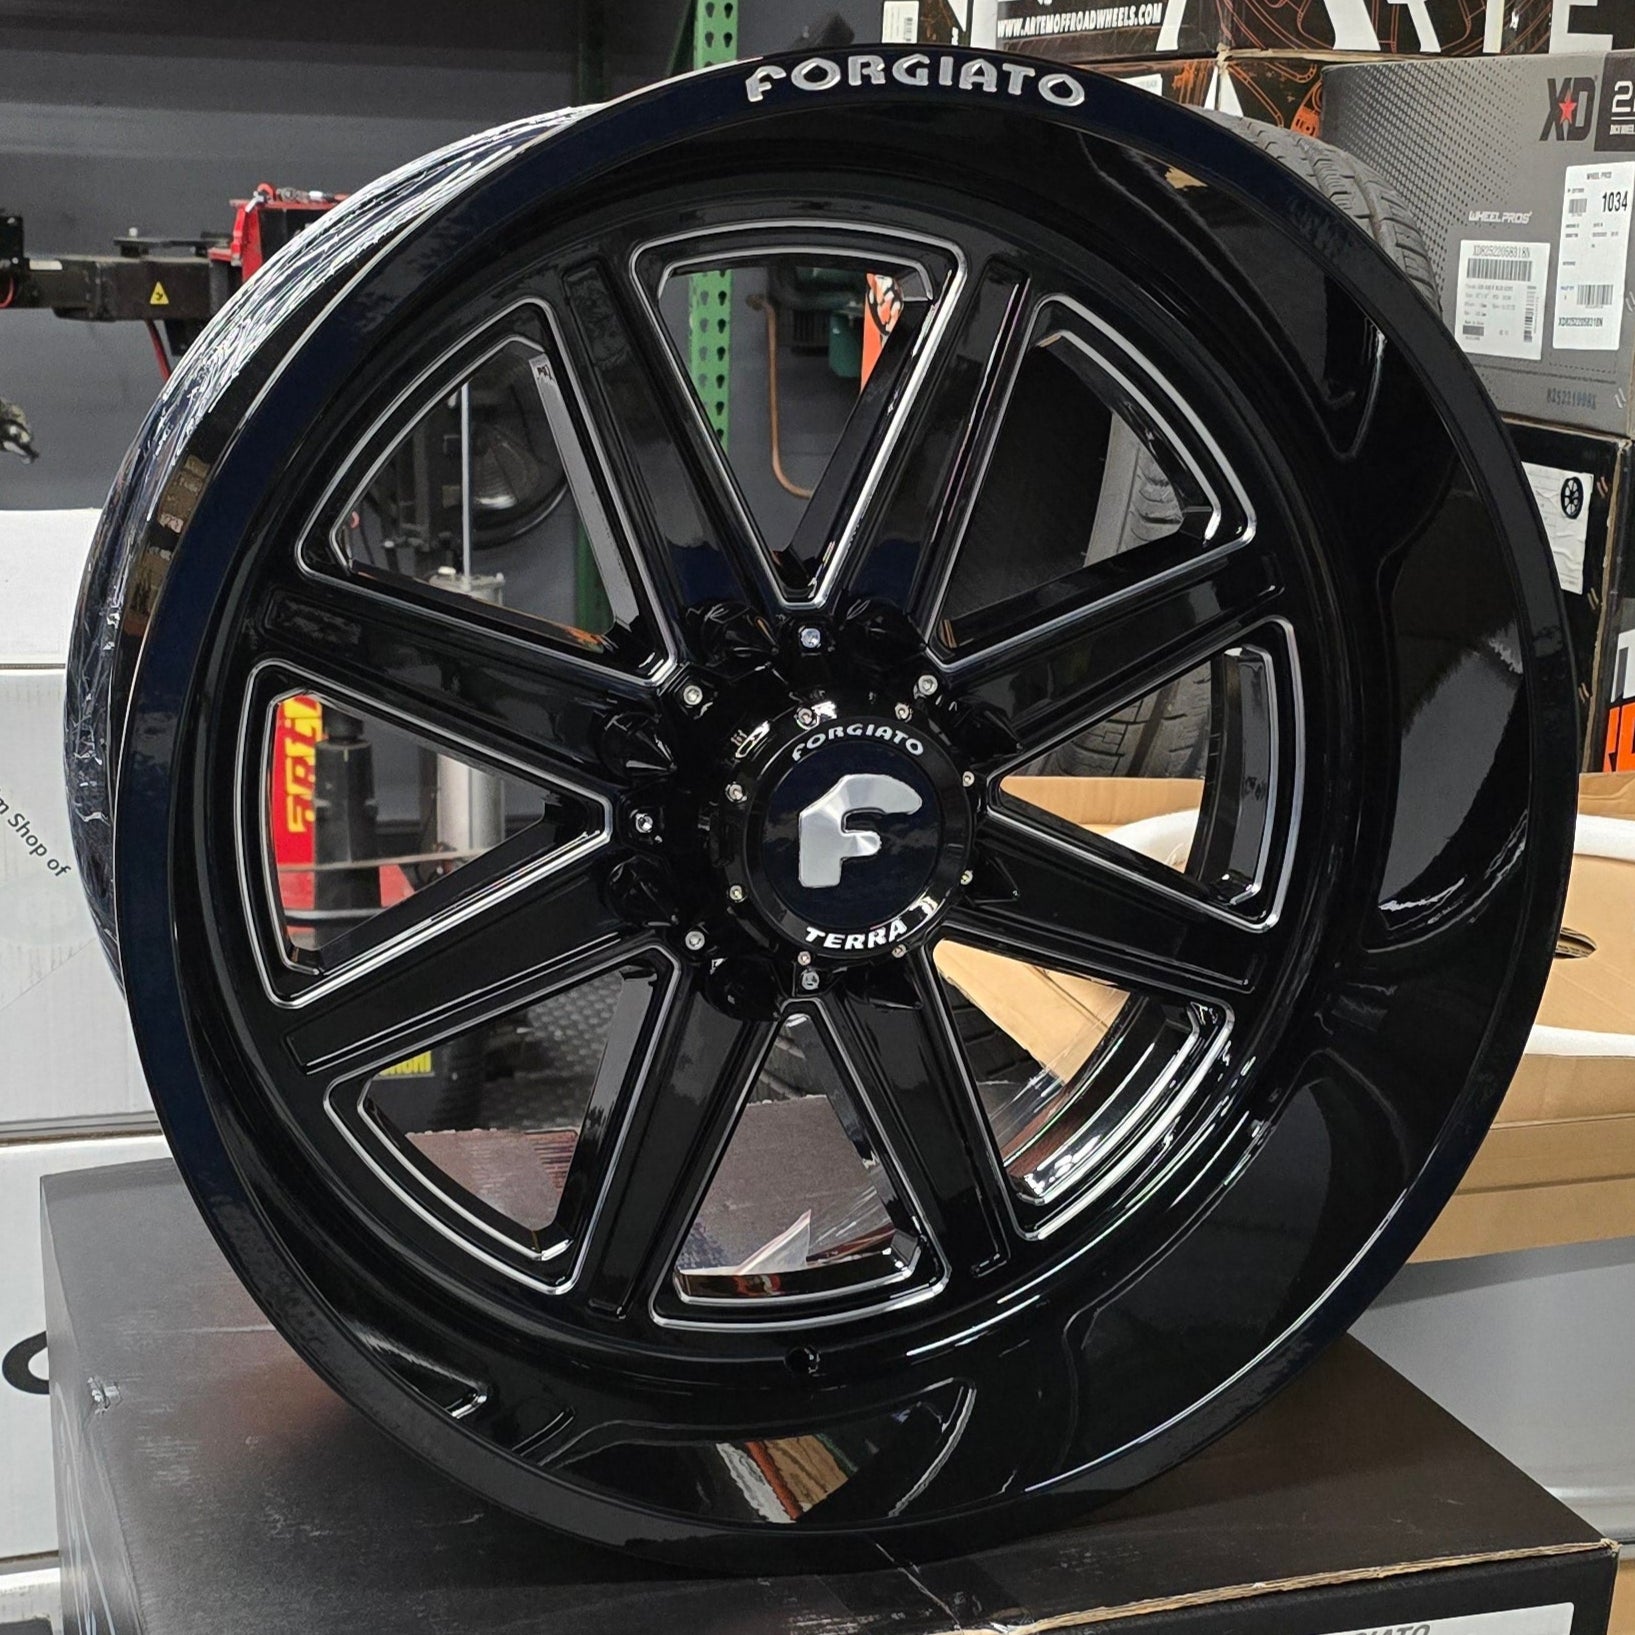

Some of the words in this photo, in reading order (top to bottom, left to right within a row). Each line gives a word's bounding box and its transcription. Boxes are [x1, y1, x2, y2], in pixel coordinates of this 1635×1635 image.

[997, 3, 1163, 38] WWW.ARTEMOFFROADWHEELS.COM
[745, 53, 1086, 107] FORGIATO
[1539, 77, 1596, 141] XD
[1602, 191, 1628, 213] 1034
[792, 723, 924, 761] FORGIATO
[8, 813, 48, 856] Shop
[47, 859, 72, 876] of
[799, 773, 923, 888] F
[804, 919, 908, 950] TERRA
